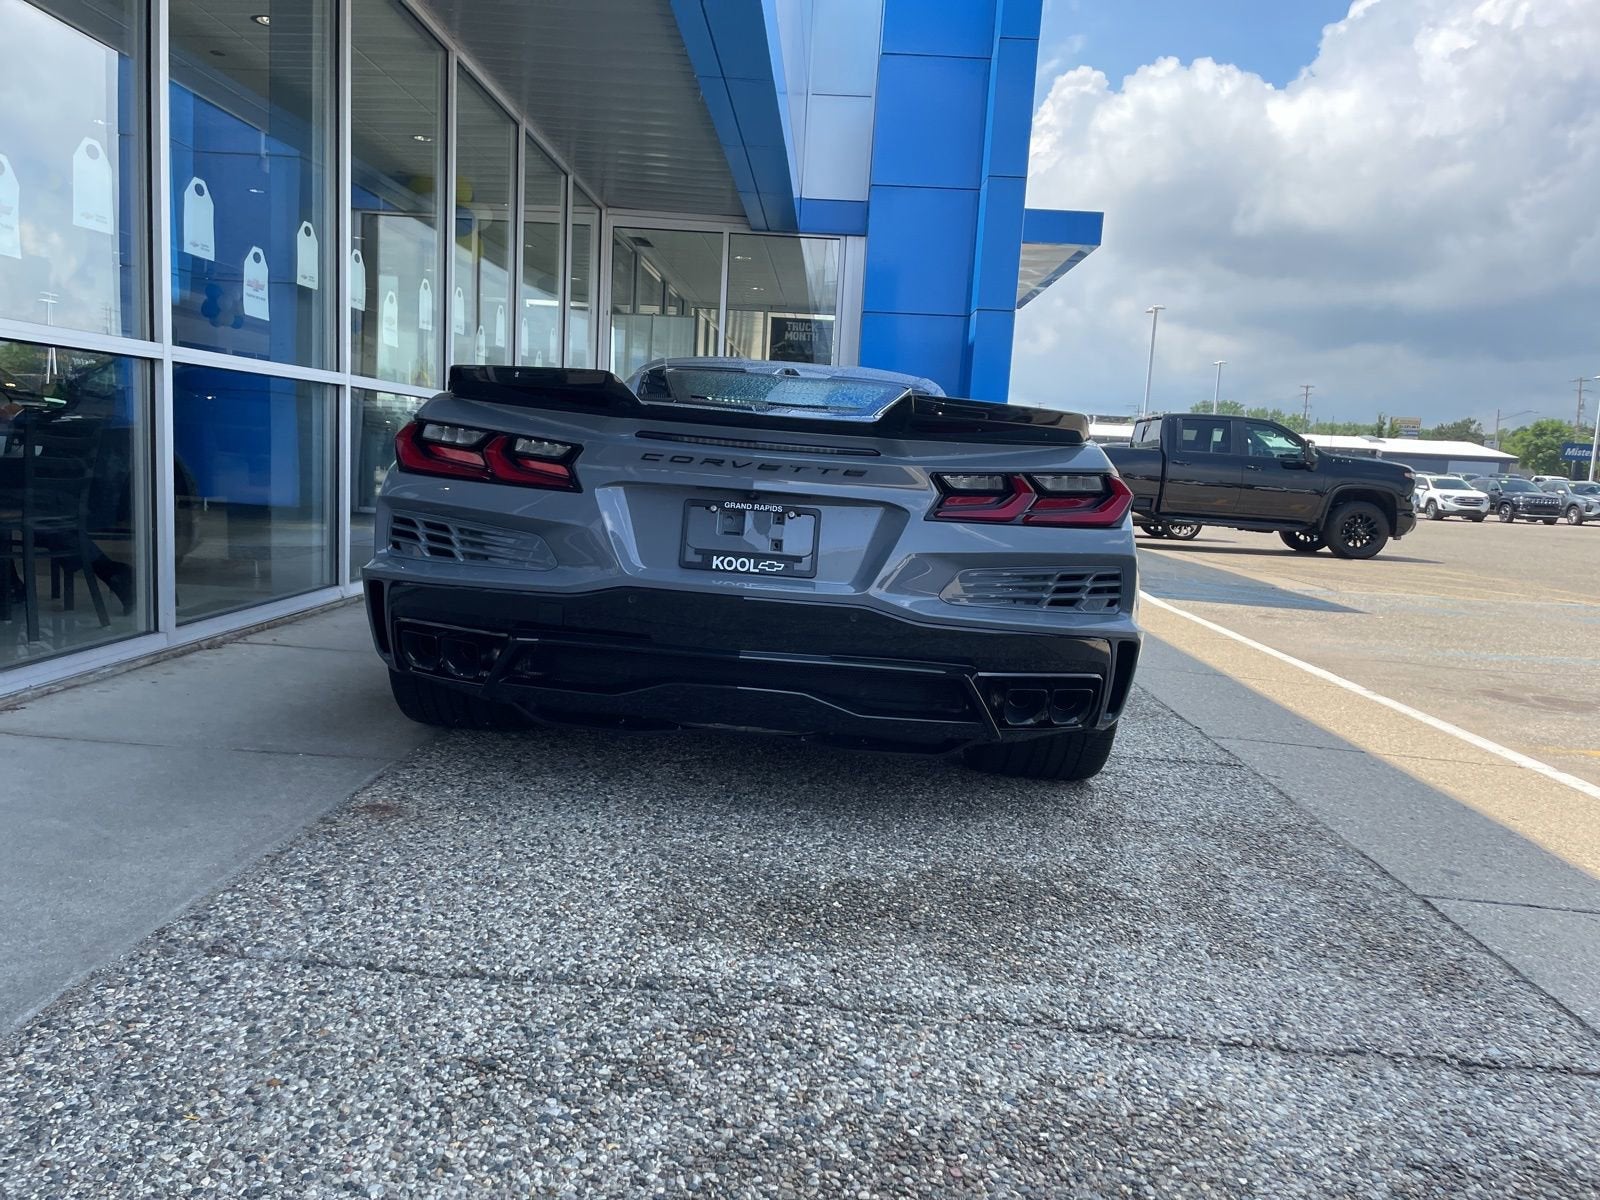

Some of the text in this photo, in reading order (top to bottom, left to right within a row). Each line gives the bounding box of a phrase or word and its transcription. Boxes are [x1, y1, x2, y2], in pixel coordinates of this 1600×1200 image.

[786, 321, 818, 332] TRUCK
[784, 331, 819, 341] MONTH
[641, 453, 868, 477] CORVETTE
[724, 502, 783, 513] GRAND RAPIDS
[712, 556, 759, 572] KOOL
